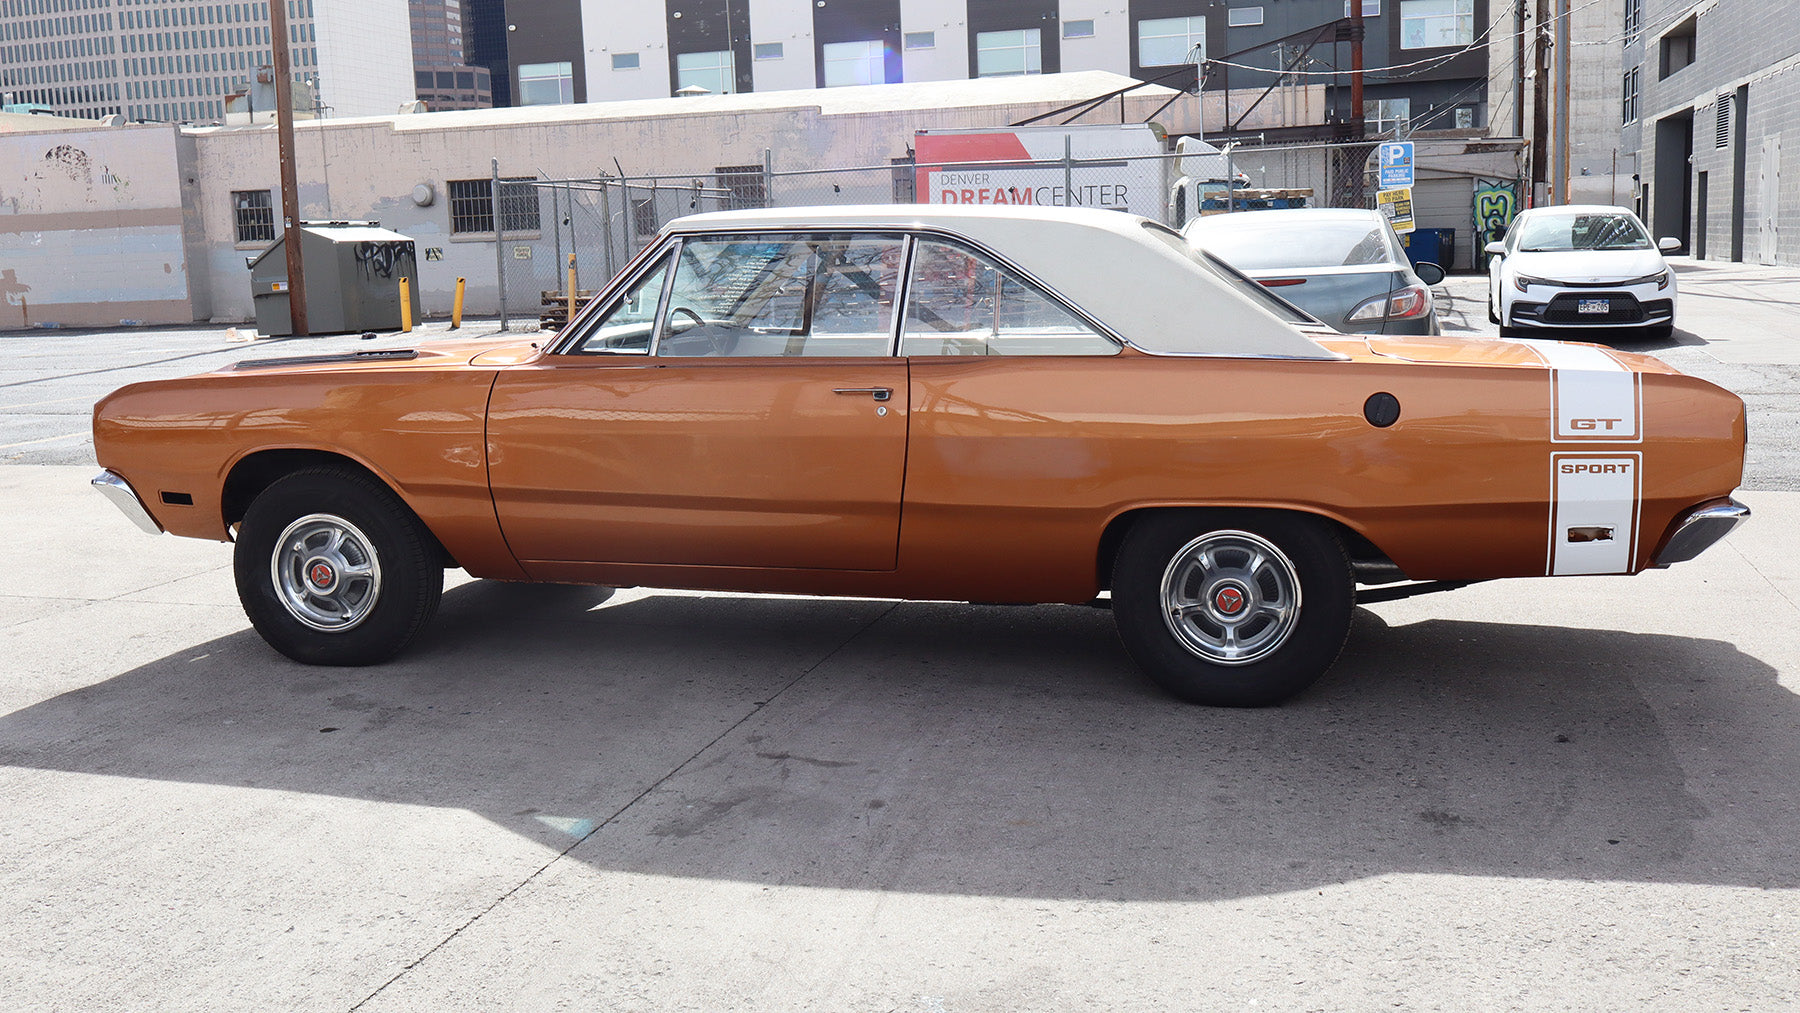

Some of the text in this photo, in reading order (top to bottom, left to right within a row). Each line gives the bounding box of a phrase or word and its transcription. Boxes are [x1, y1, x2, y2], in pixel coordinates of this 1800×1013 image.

[1389, 145, 1404, 165] P
[940, 173, 990, 186] DENVER
[1570, 418, 1622, 430] GT
[1561, 464, 1631, 474] SPORT
